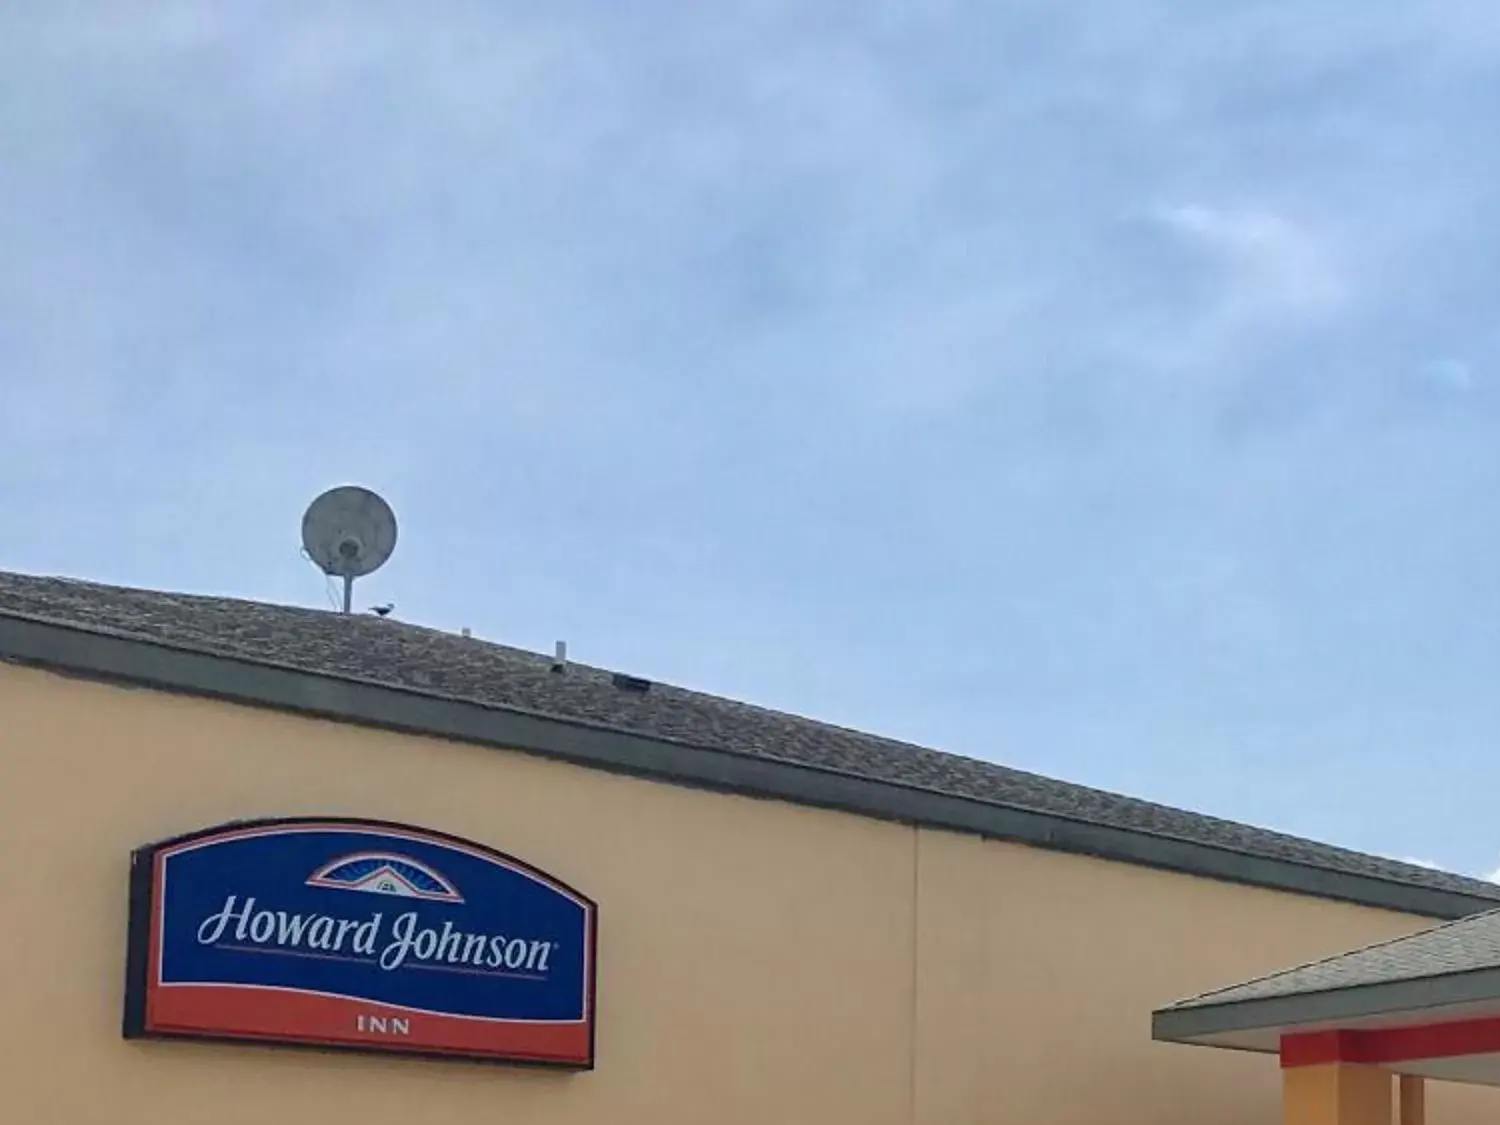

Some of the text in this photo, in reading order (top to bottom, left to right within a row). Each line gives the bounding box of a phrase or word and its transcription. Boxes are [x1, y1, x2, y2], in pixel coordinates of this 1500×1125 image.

[197, 895, 555, 972] Howard Johnson
[356, 1015, 411, 1036] INN
